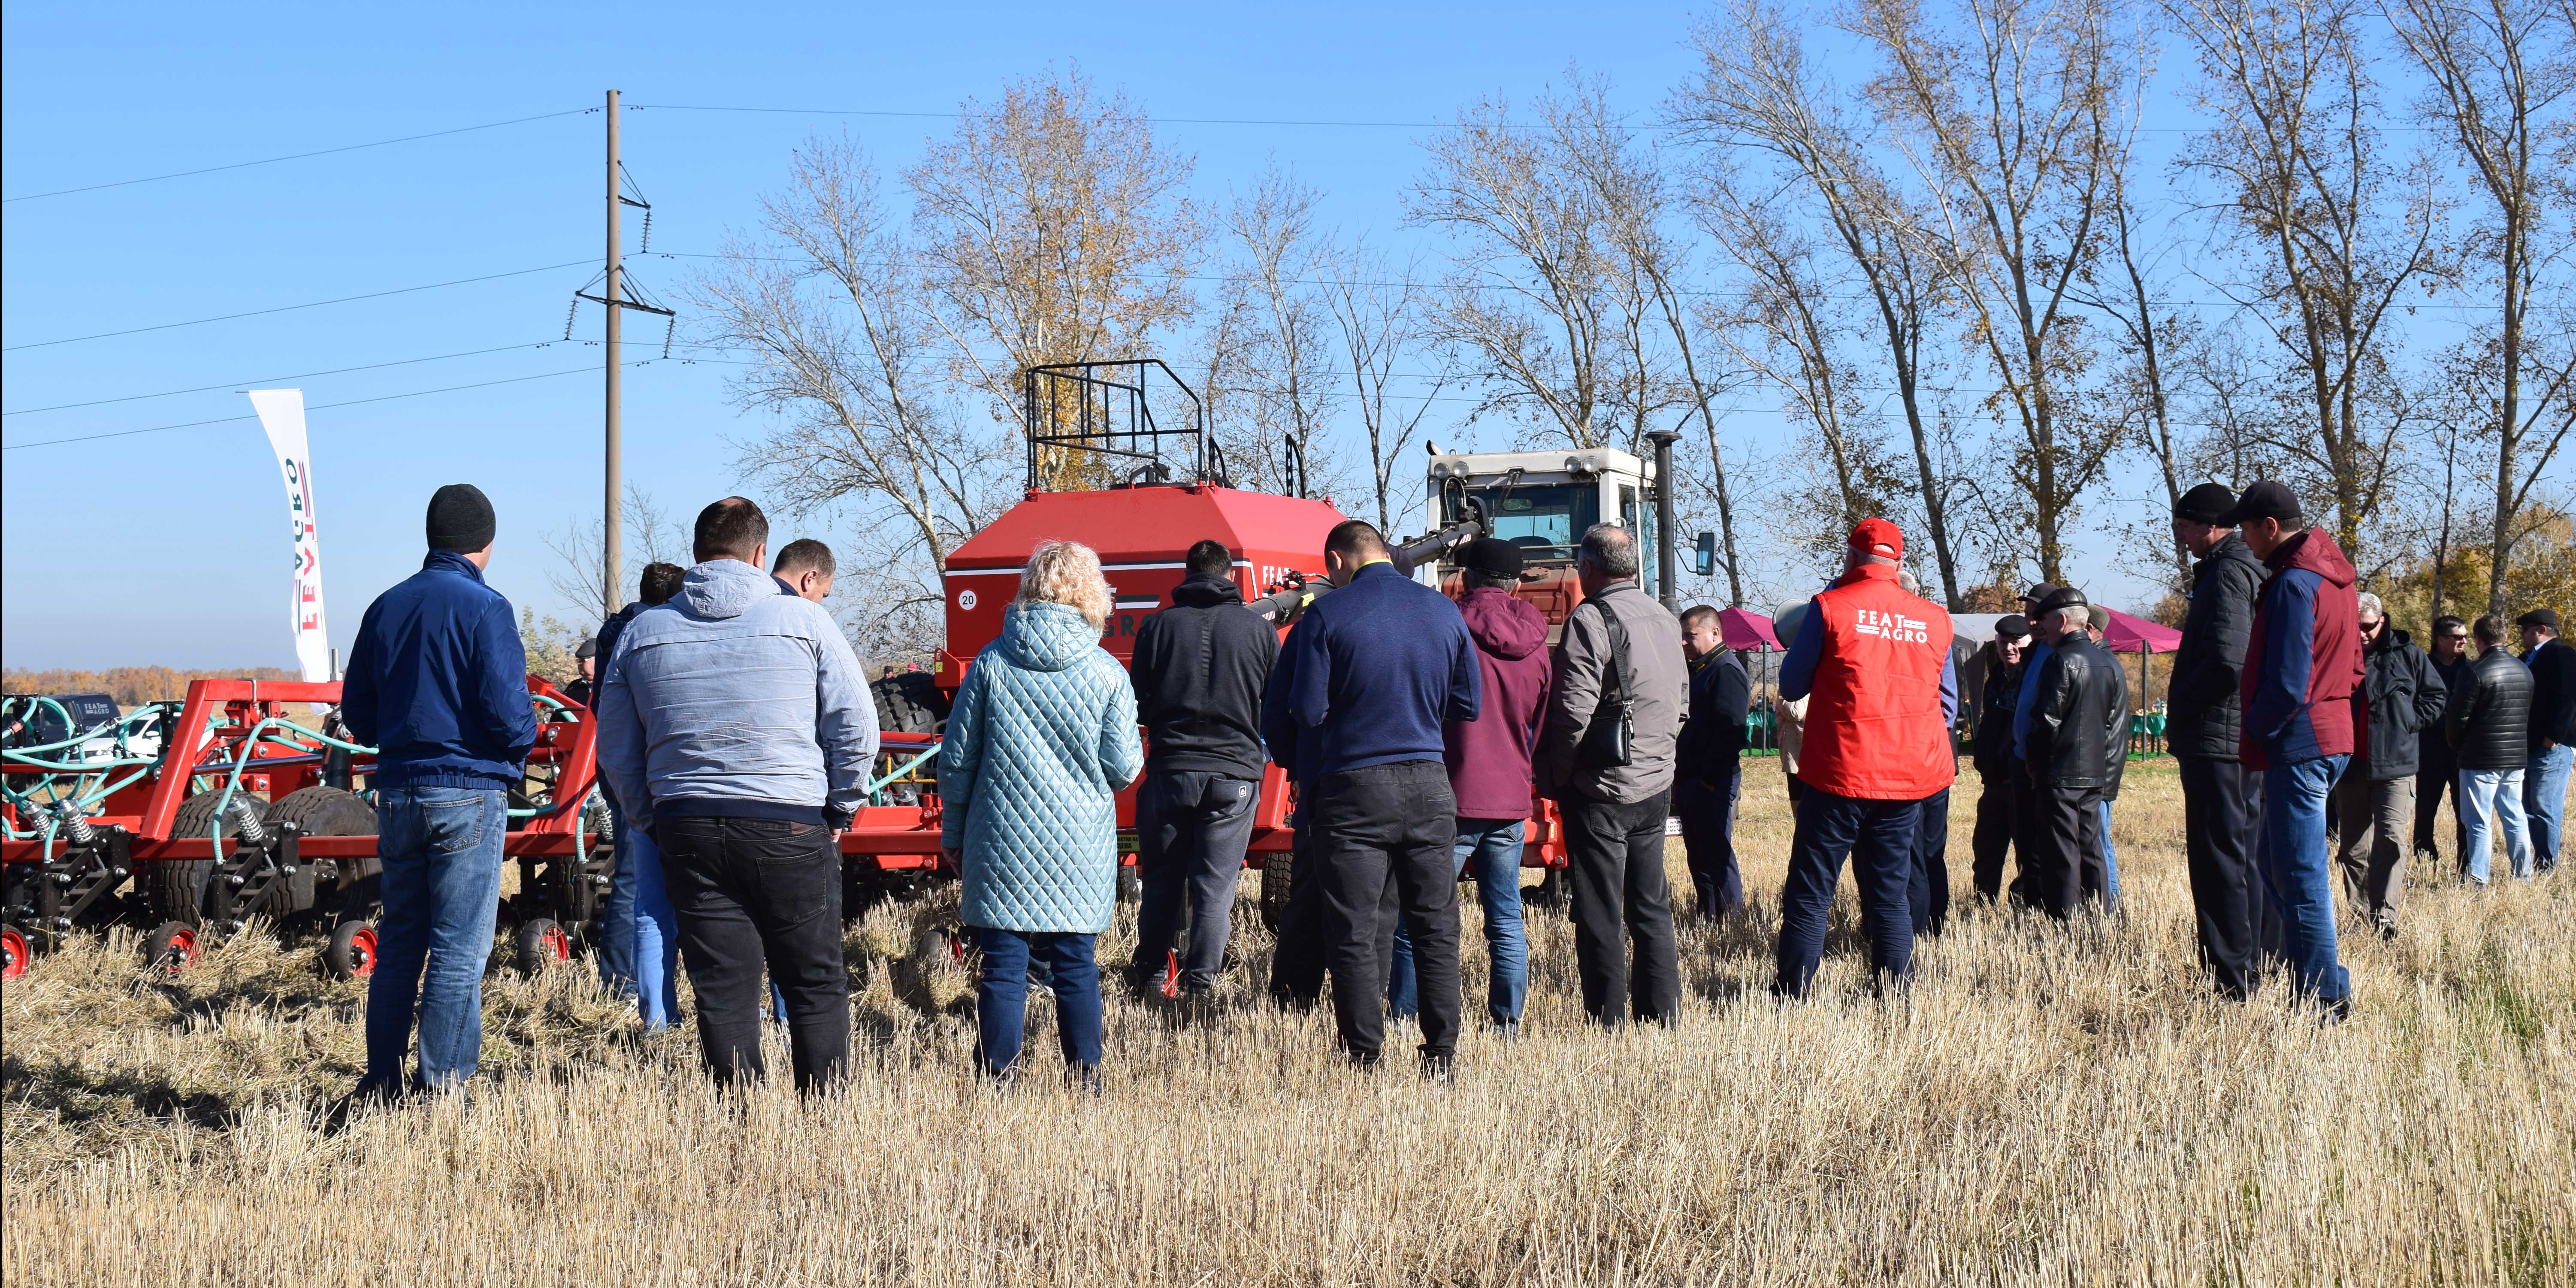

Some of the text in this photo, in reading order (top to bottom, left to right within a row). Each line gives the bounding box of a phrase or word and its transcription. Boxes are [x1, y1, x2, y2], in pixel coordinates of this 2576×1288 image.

[962, 595, 974, 605] 20
[1858, 609, 1905, 628] FEAT
[1880, 626, 1928, 643] AGRO
